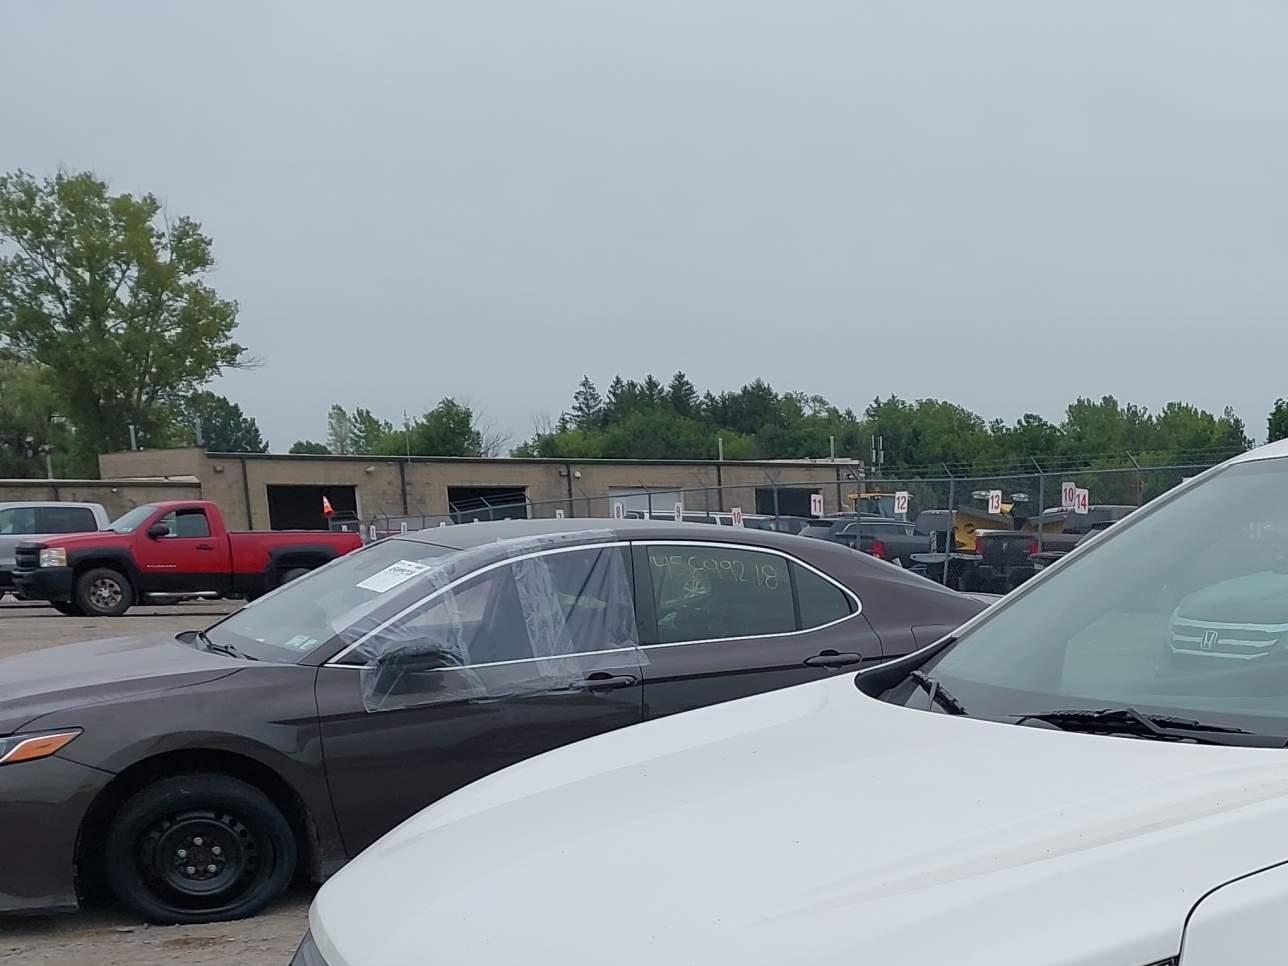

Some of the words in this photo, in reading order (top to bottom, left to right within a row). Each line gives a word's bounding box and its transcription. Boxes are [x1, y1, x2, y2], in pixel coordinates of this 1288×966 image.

[990, 494, 1000, 510] 13
[1063, 487, 1074, 502] 10
[1076, 493, 1087, 510] 14
[813, 498, 822, 512] 11
[896, 495, 907, 510] 12
[733, 511, 741, 524] 10
